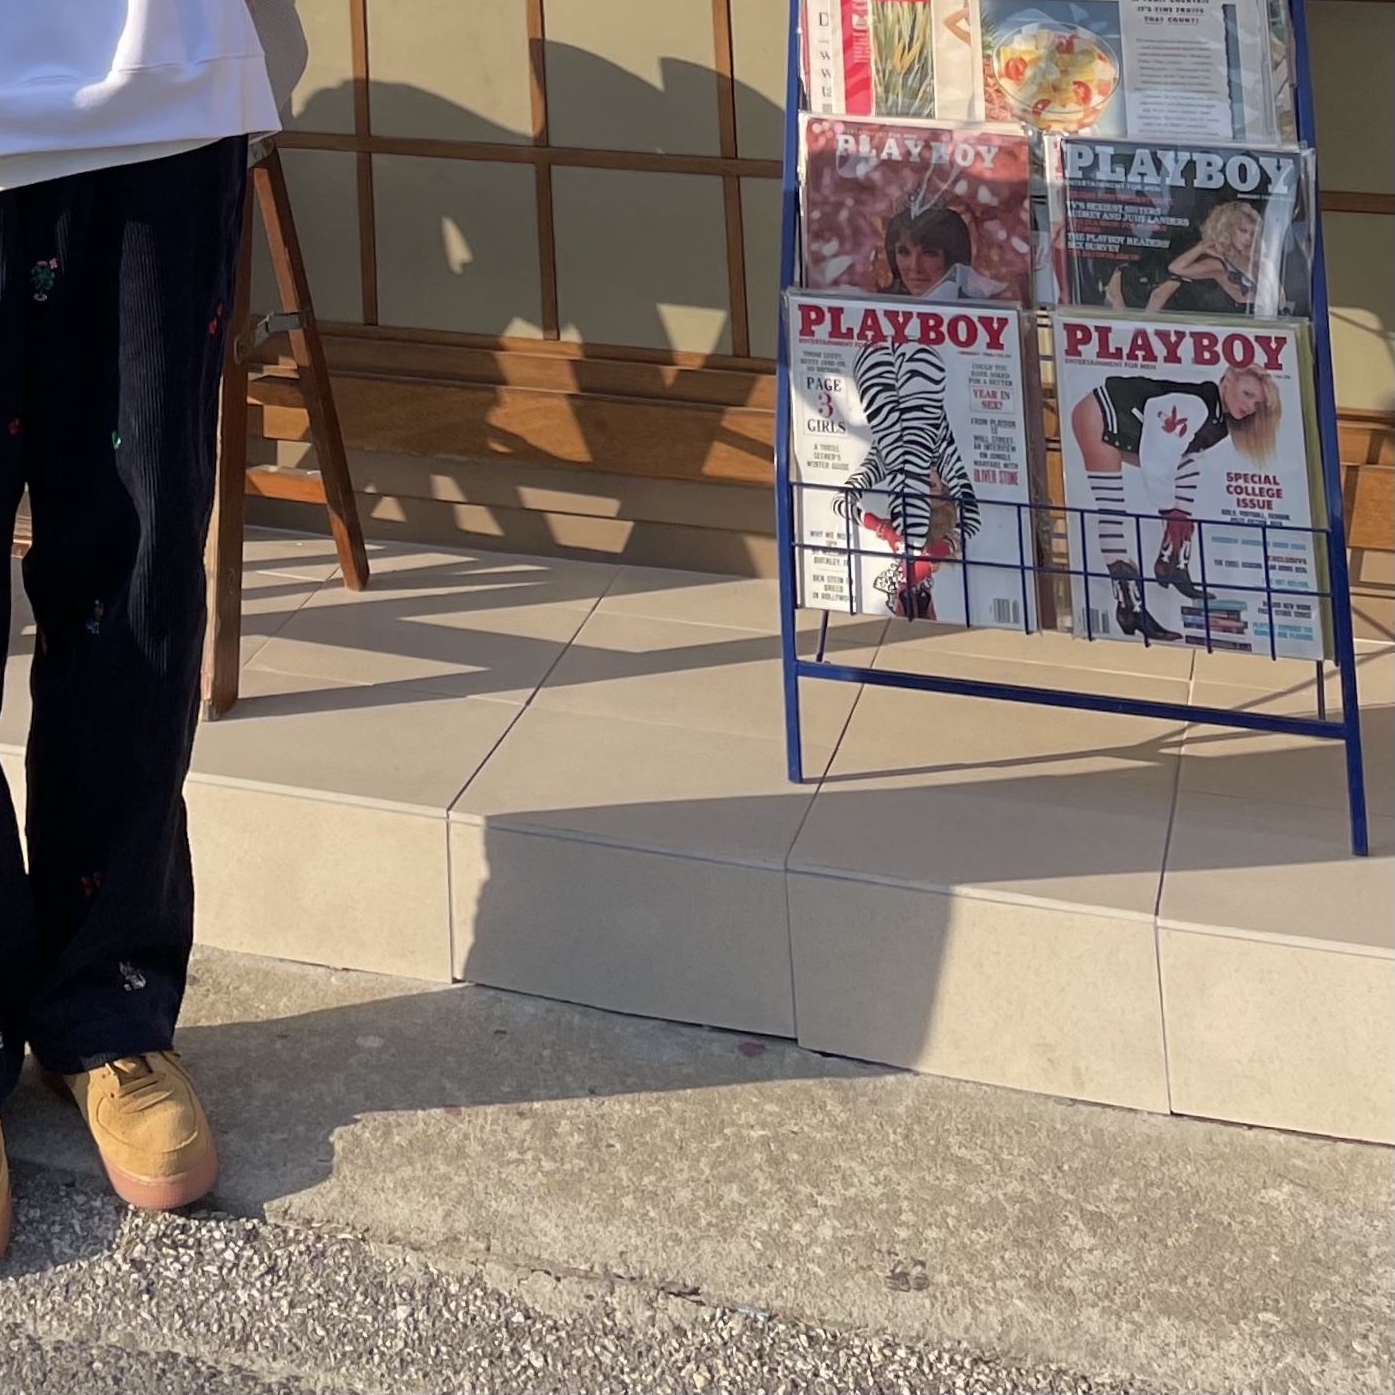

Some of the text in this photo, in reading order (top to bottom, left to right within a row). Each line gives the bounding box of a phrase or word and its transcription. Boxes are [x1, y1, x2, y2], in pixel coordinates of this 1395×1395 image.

[836, 134, 999, 169] PLAYBOY
[1065, 142, 1295, 194] PLAYBOY
[1102, 212, 1121, 221] AND
[798, 304, 1009, 350] PLAYBOY
[1063, 322, 1287, 371] PLAYBOY
[1124, 361, 1138, 369] FOR
[806, 376, 842, 392] PAGE
[973, 389, 1011, 400] YEAR IN
[818, 392, 834, 418] 3
[807, 419, 846, 434] GIRLS
[1226, 472, 1280, 486] SPECIAL
[1226, 484, 1283, 499] COLLEGE
[1236, 497, 1273, 510] ISSUE
